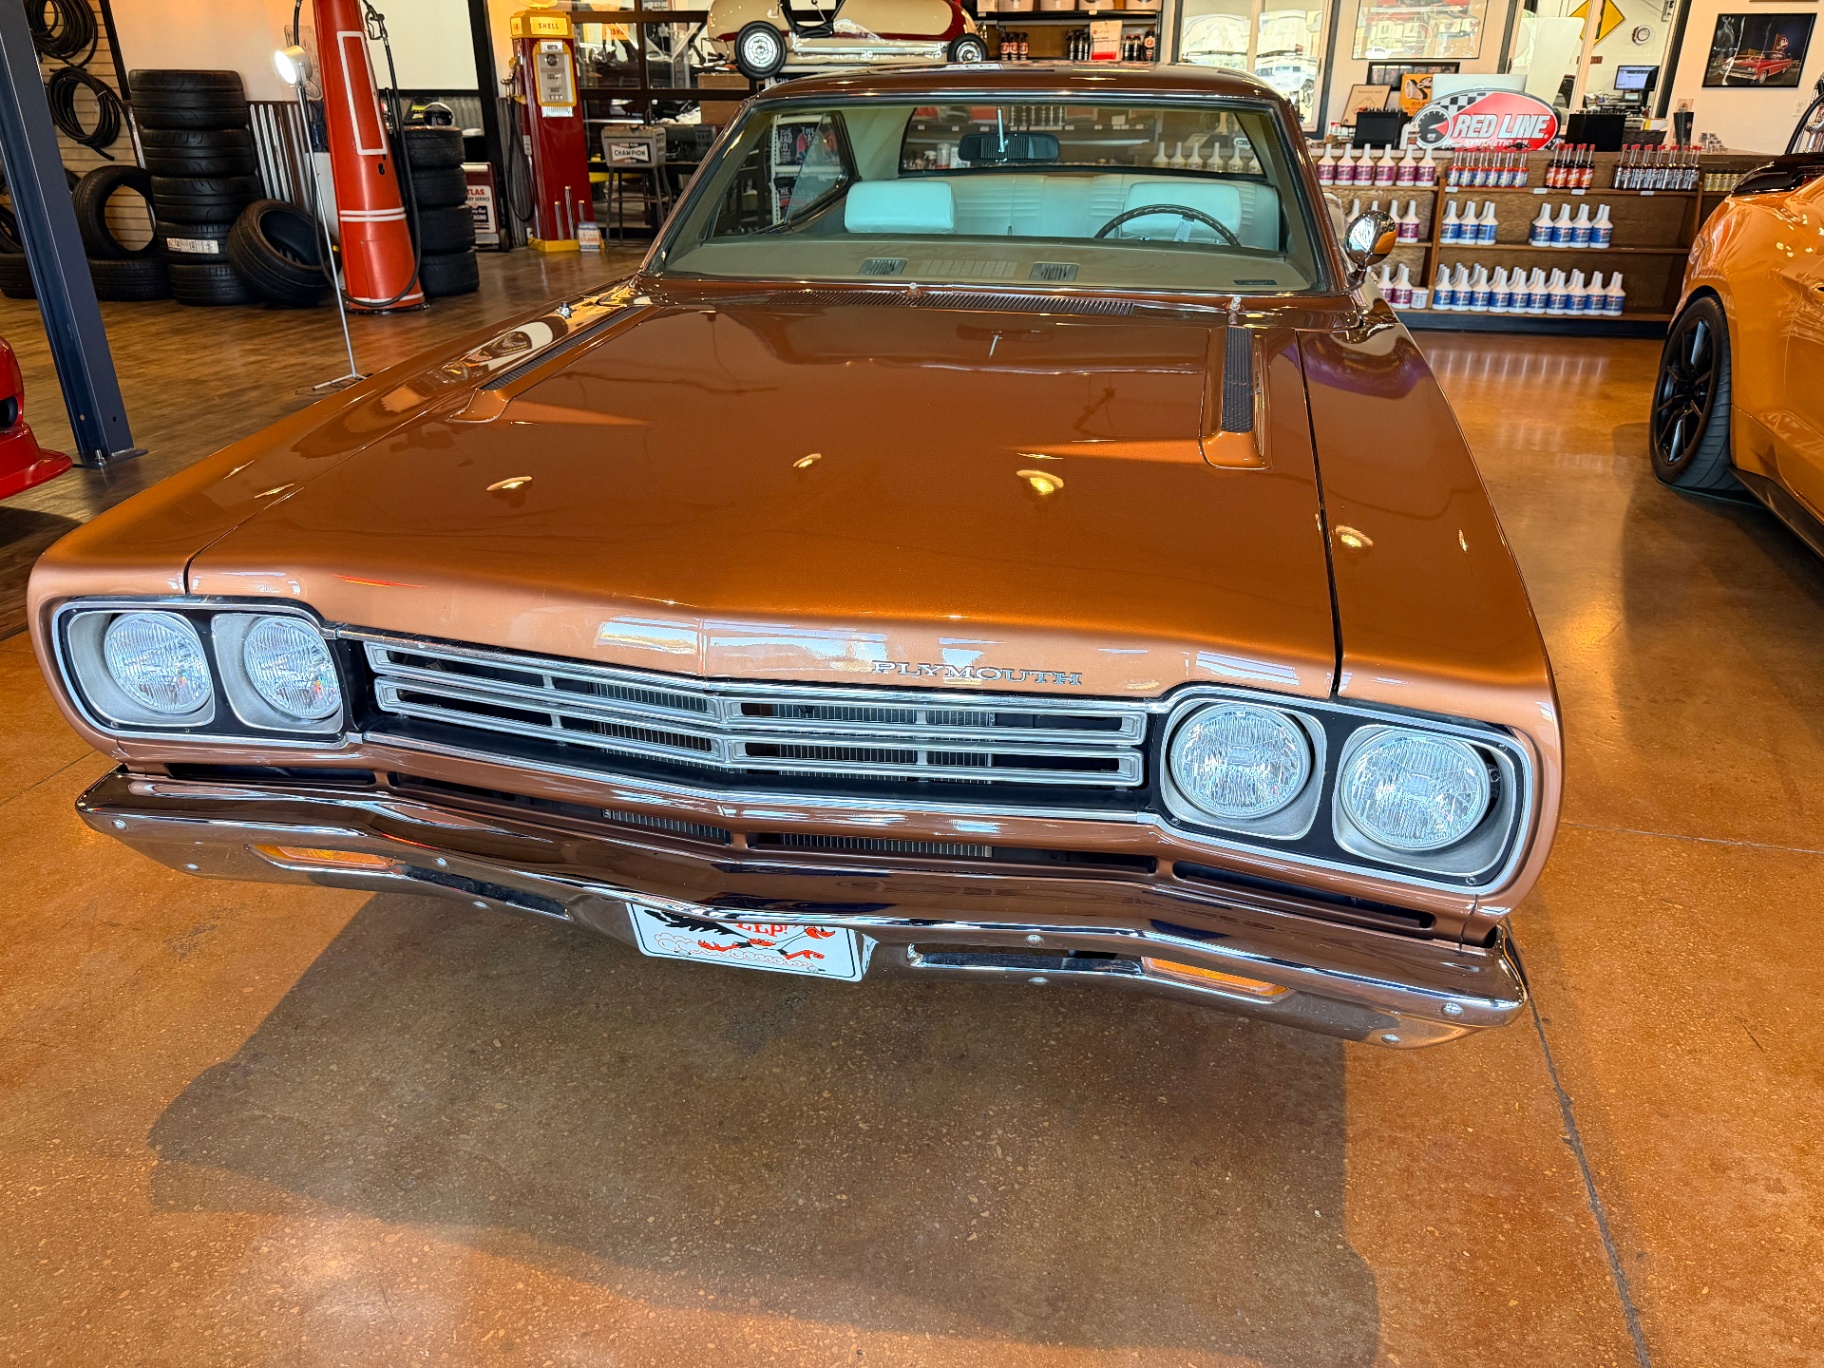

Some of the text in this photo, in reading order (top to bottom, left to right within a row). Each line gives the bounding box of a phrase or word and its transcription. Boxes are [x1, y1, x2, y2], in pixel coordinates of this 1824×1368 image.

[538, 22, 560, 30] SHELL
[1452, 114, 1551, 138] RED LINE
[613, 149, 646, 157] CHAMPION
[466, 188, 485, 196] TLAS
[872, 660, 1083, 686] PLYMOUTH
